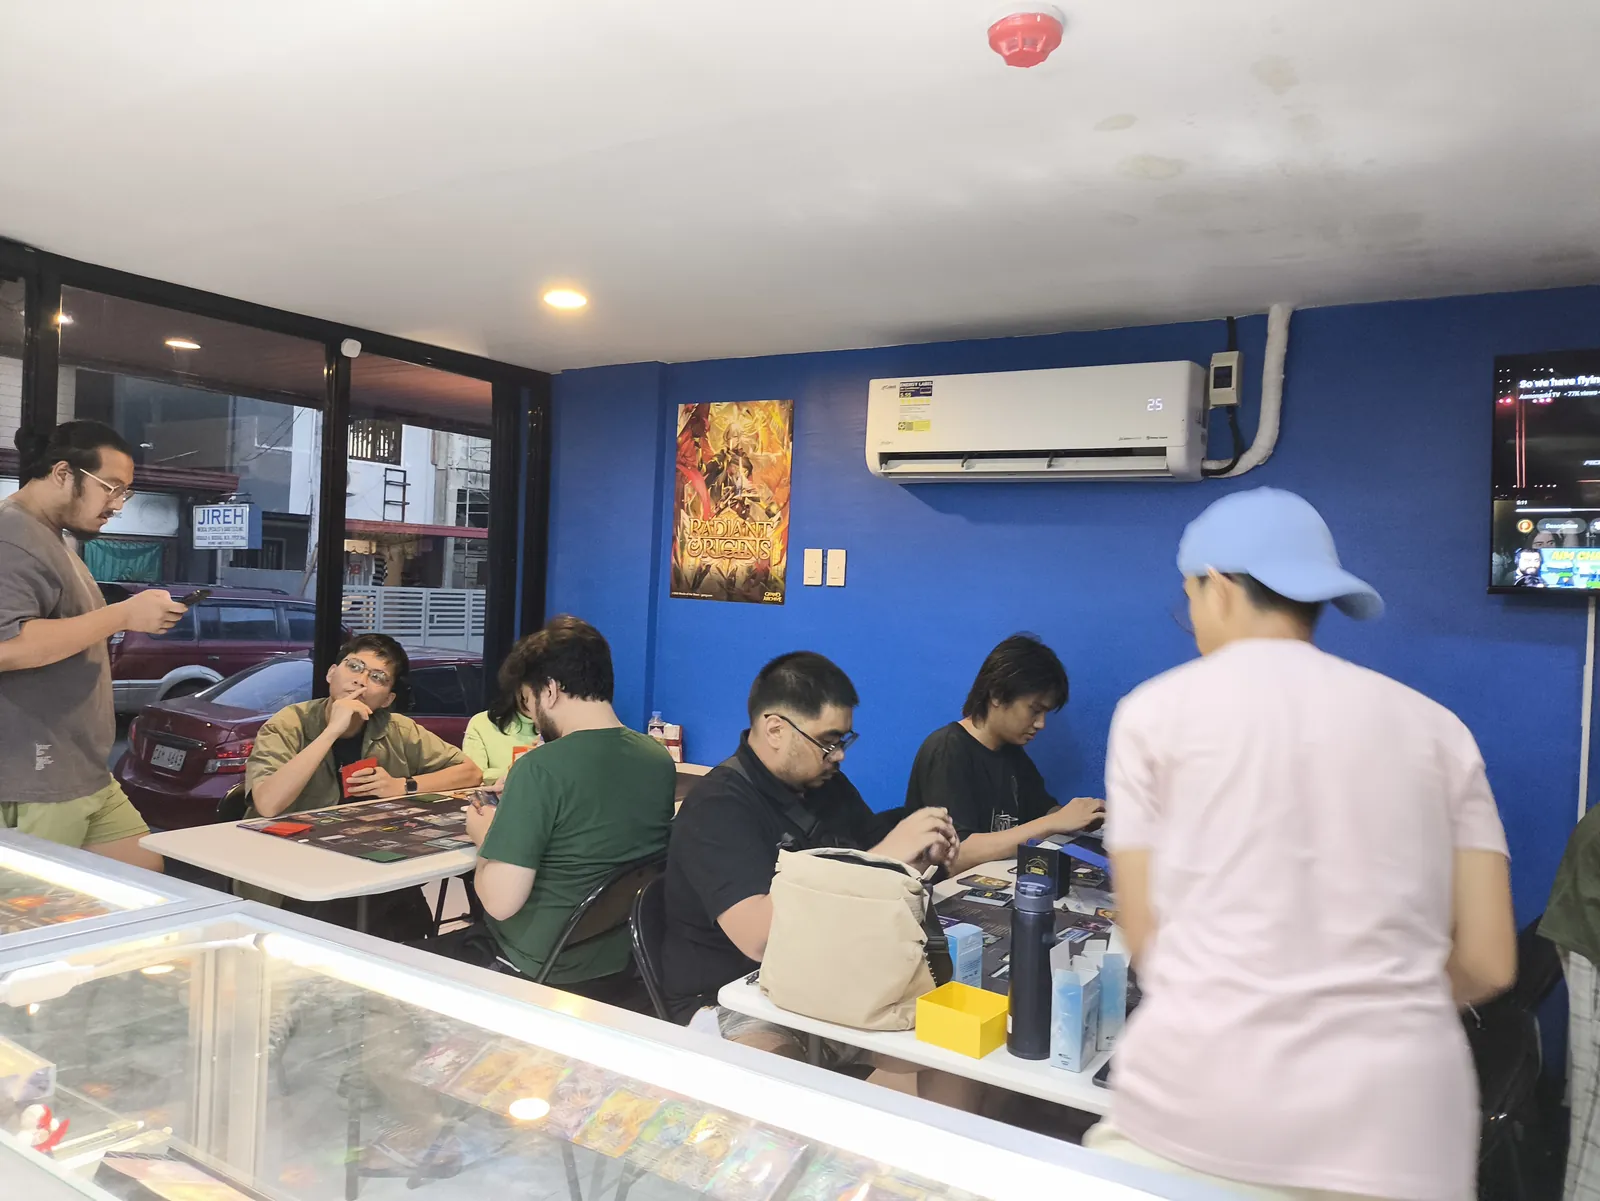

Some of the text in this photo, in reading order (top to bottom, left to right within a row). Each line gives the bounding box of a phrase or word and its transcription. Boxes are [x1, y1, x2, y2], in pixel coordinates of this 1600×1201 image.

[1519, 380, 1533, 388] So
[1534, 379, 1549, 388] we
[1550, 377, 1576, 387] have
[1147, 398, 1163, 411] 25
[198, 509, 244, 525] JIREH
[689, 518, 774, 539] RADIANT
[687, 538, 772, 560] ORIGINS
